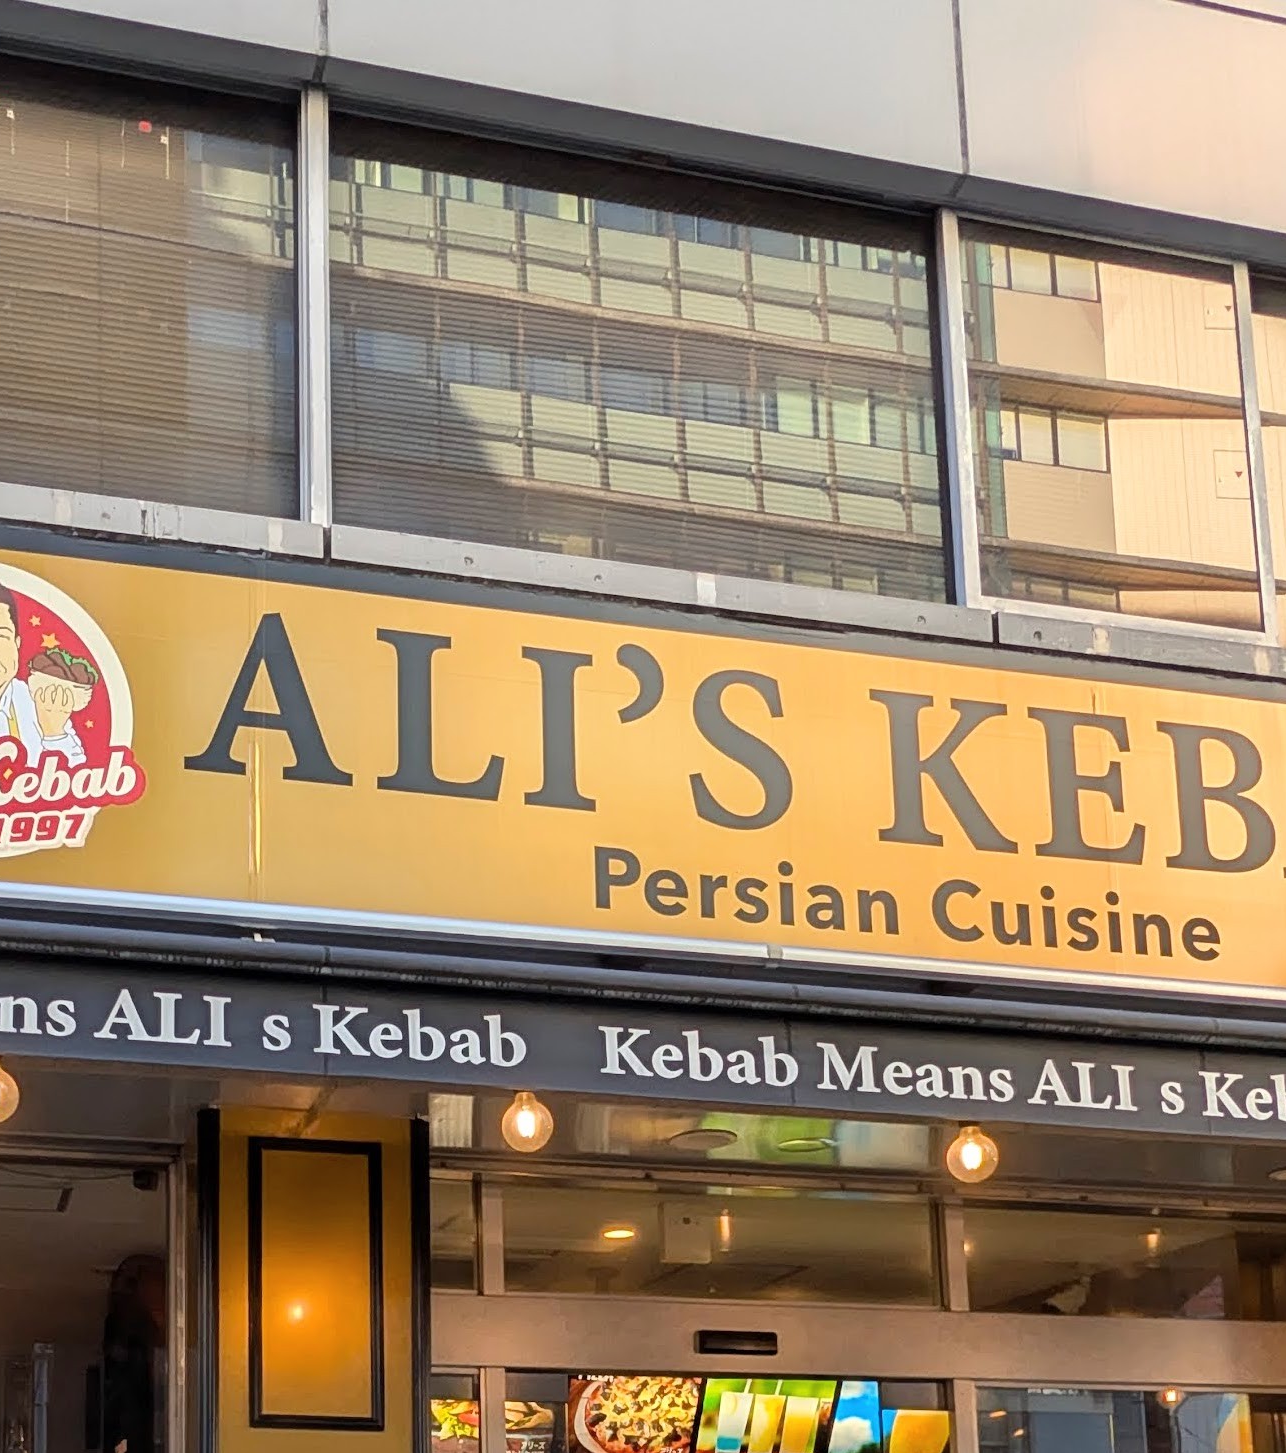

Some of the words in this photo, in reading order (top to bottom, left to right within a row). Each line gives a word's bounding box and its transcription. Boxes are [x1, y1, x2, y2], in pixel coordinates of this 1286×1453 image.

[594, 846, 900, 935] Persian
[931, 880, 1222, 961] Cuisine
[93, 989, 232, 1048] ALI
[262, 1012, 289, 1051] s
[313, 1004, 527, 1067] Kebab
[598, 1025, 799, 1087] Kebab
[816, 1042, 1014, 1104] Means
[1027, 1059, 1138, 1112] ALI
[1160, 1079, 1185, 1115] s
